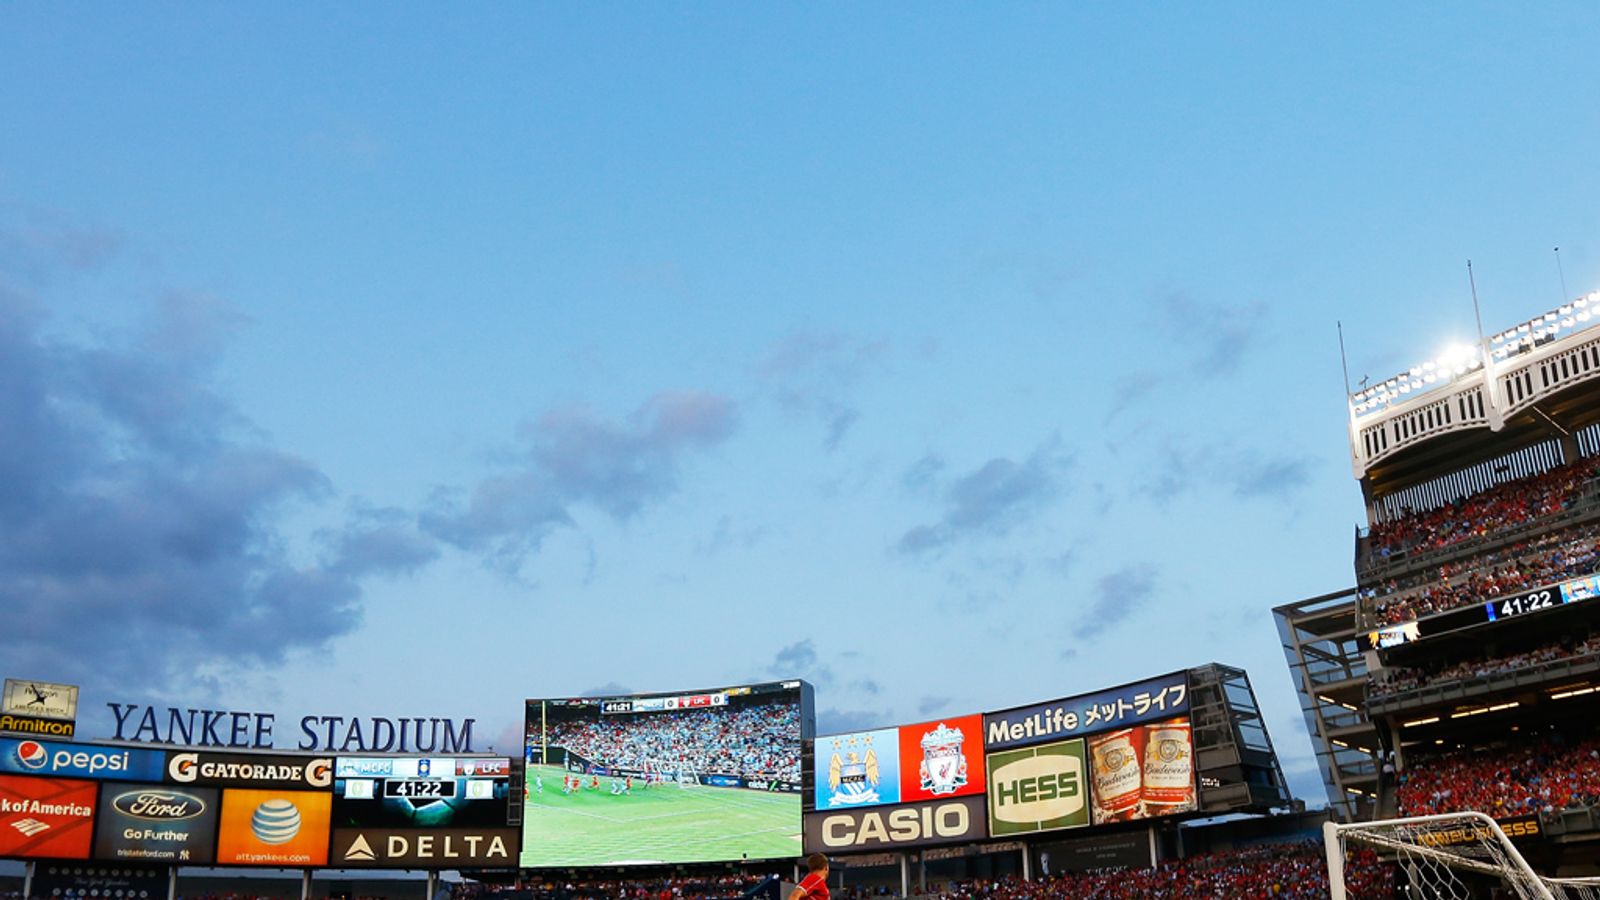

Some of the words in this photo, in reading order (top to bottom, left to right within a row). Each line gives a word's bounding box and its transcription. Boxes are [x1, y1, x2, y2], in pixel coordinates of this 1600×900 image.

[1501, 591, 1553, 616] 41:22
[605, 703, 630, 711] 41:21
[988, 708, 1079, 744] MetLife
[1085, 684, 1186, 727] メットライフ
[0, 715, 73, 735] Armitron
[107, 703, 275, 749] YANKEE
[299, 715, 475, 753] STADIUM
[52, 751, 129, 773] pepsi
[201, 763, 302, 781] GATORADE
[483, 763, 501, 773] LFC
[396, 782, 441, 796] 41:22
[997, 771, 1078, 806] HESS
[13, 799, 30, 812] of
[30, 800, 91, 816] America
[130, 793, 189, 817] Ford
[123, 828, 142, 839] Go
[144, 829, 189, 841] Further
[822, 803, 969, 847] CASIO
[117, 849, 175, 858] tristateford.com
[387, 836, 508, 858] DELTA
